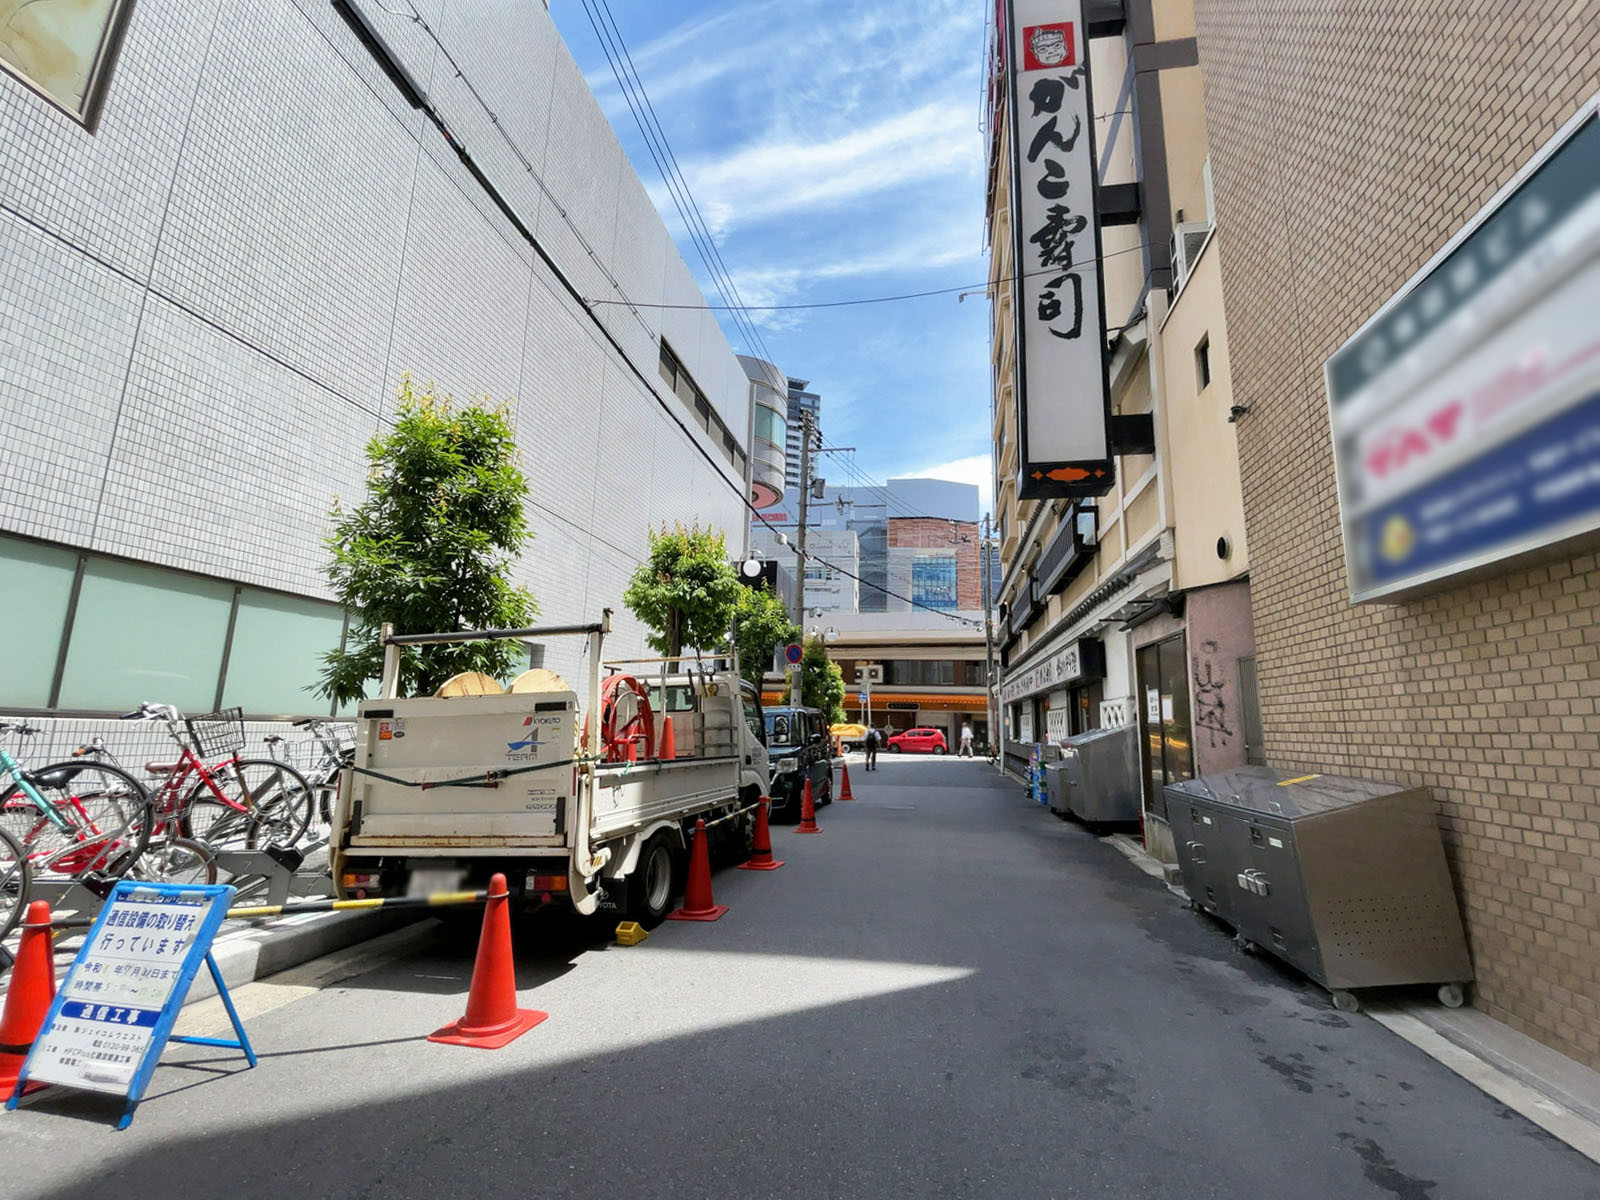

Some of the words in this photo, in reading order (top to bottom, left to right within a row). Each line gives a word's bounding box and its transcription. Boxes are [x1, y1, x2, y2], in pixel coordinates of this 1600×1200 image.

[505, 753, 538, 761] TEAM
[105, 909, 196, 932] 通信設備の取り替え
[99, 932, 185, 955] 行っています
[79, 1004, 142, 1024] 通信工事
